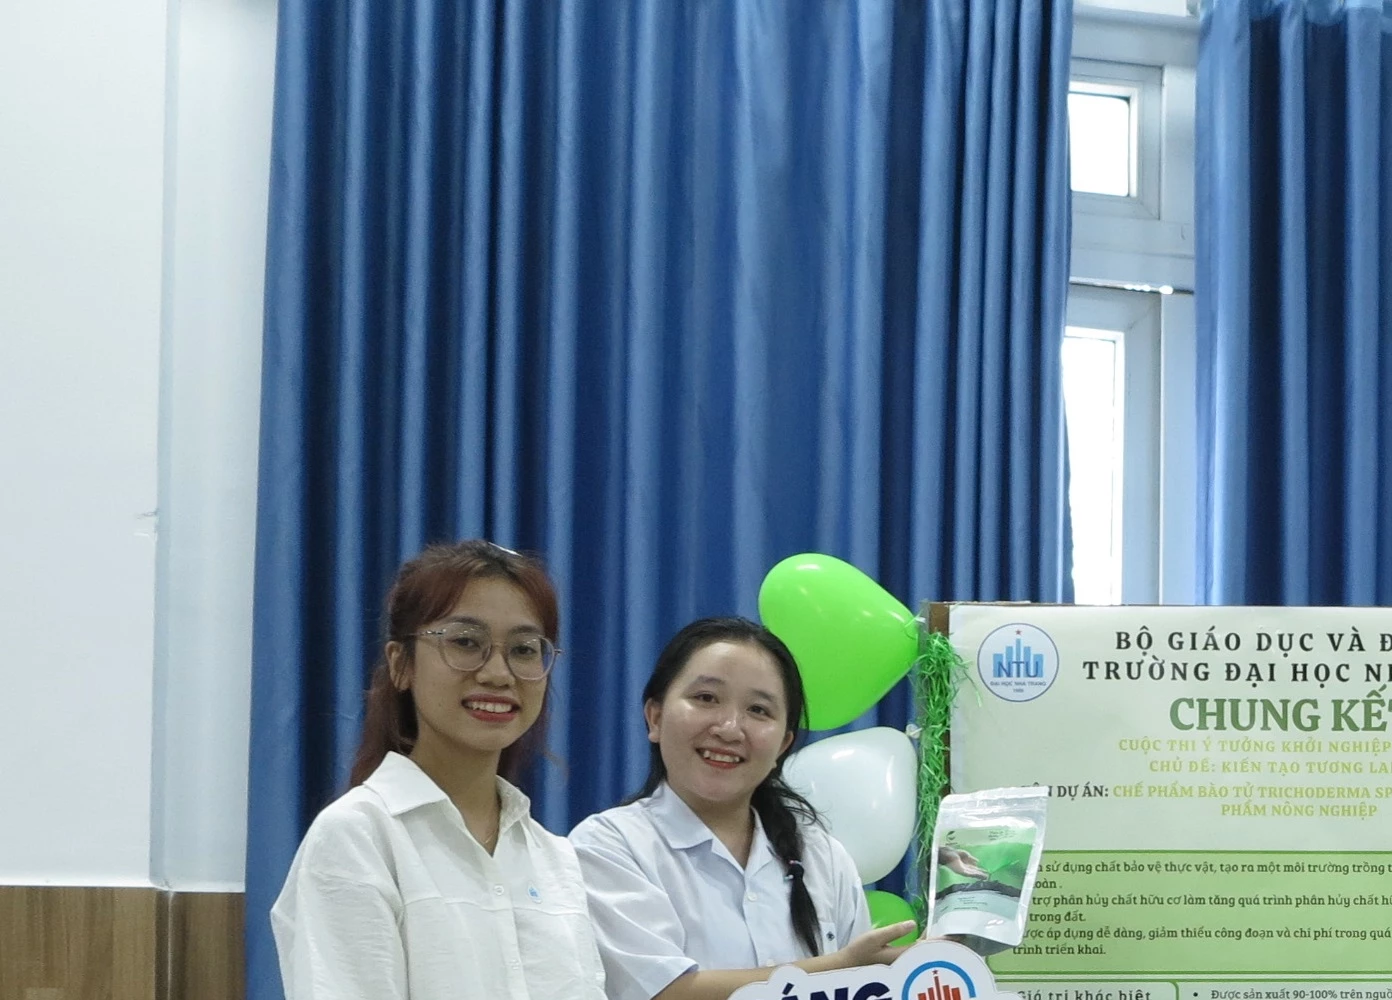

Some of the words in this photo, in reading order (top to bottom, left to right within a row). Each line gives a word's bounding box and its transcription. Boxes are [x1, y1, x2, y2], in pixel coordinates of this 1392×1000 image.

[1115, 626, 1153, 656] BỘ
[1168, 625, 1241, 652] GIÁO
[1256, 632, 1314, 657] DỤC
[1327, 626, 1366, 652] VÀ
[997, 661, 1039, 678] NTU
[1083, 656, 1210, 682] TRƯỜNG
[1225, 662, 1276, 688] ĐẠI
[1291, 663, 1350, 689] HỌC
[1169, 697, 1321, 731] CHUNG
[1119, 736, 1161, 755] CUỘC
[1167, 739, 1196, 751] THI
[1203, 736, 1211, 751] Ý
[1219, 736, 1275, 752] TƯỞNG
[1282, 736, 1322, 752] KHỞI
[1328, 737, 1392, 756] NGHIỆP
[1149, 756, 1183, 772] CHỦ
[1222, 757, 1261, 772] KIẾN
[1267, 761, 1300, 776] TẠO
[1306, 761, 1363, 774] TƯƠNG
[1057, 784, 1079, 801] DỰ
[1082, 781, 1109, 797] ÁN:
[1112, 781, 1144, 797] CHẾ
[1258, 787, 1371, 799] TRICHODERMA
[1271, 801, 1314, 816] NÔNG
[1320, 801, 1377, 820] NGHIỆP
[1063, 862, 1092, 874] dụng
[1095, 860, 1120, 872] chất
[1124, 861, 1144, 872] bảo
[1148, 861, 1161, 874] vệ
[1165, 862, 1192, 874] thực
[1220, 863, 1238, 874] tạo
[1241, 864, 1254, 872] ra
[1257, 862, 1281, 874] một
[1283, 862, 1305, 872] môi
[1308, 862, 1349, 875] trường
[1053, 895, 1083, 907] phân
[1112, 893, 1137, 905] chất
[1140, 894, 1164, 905] hữu
[1184, 894, 1206, 905] làm
[1209, 895, 1235, 907] tăng
[1238, 894, 1260, 907] quá
[1263, 894, 1292, 905] trình
[1295, 894, 1325, 907] phân
[1353, 893, 1379, 905] chất
[1029, 913, 1061, 924] trong
[1046, 927, 1061, 941] áp
[1064, 928, 1093, 940] dụng
[1149, 926, 1178, 940] giảm
[1215, 927, 1242, 940] công
[1245, 927, 1274, 940] đoạn
[1276, 927, 1290, 938] và
[1293, 927, 1311, 938] chi
[1313, 927, 1332, 940] phí
[1335, 929, 1367, 940] trong
[1369, 927, 1391, 940] quá
[1077, 944, 1106, 955] khai.
[1211, 989, 1241, 1000] Được
[1265, 987, 1290, 999] xuất
[1292, 989, 1338, 999] 90-100%
[1340, 989, 1363, 999] trên
